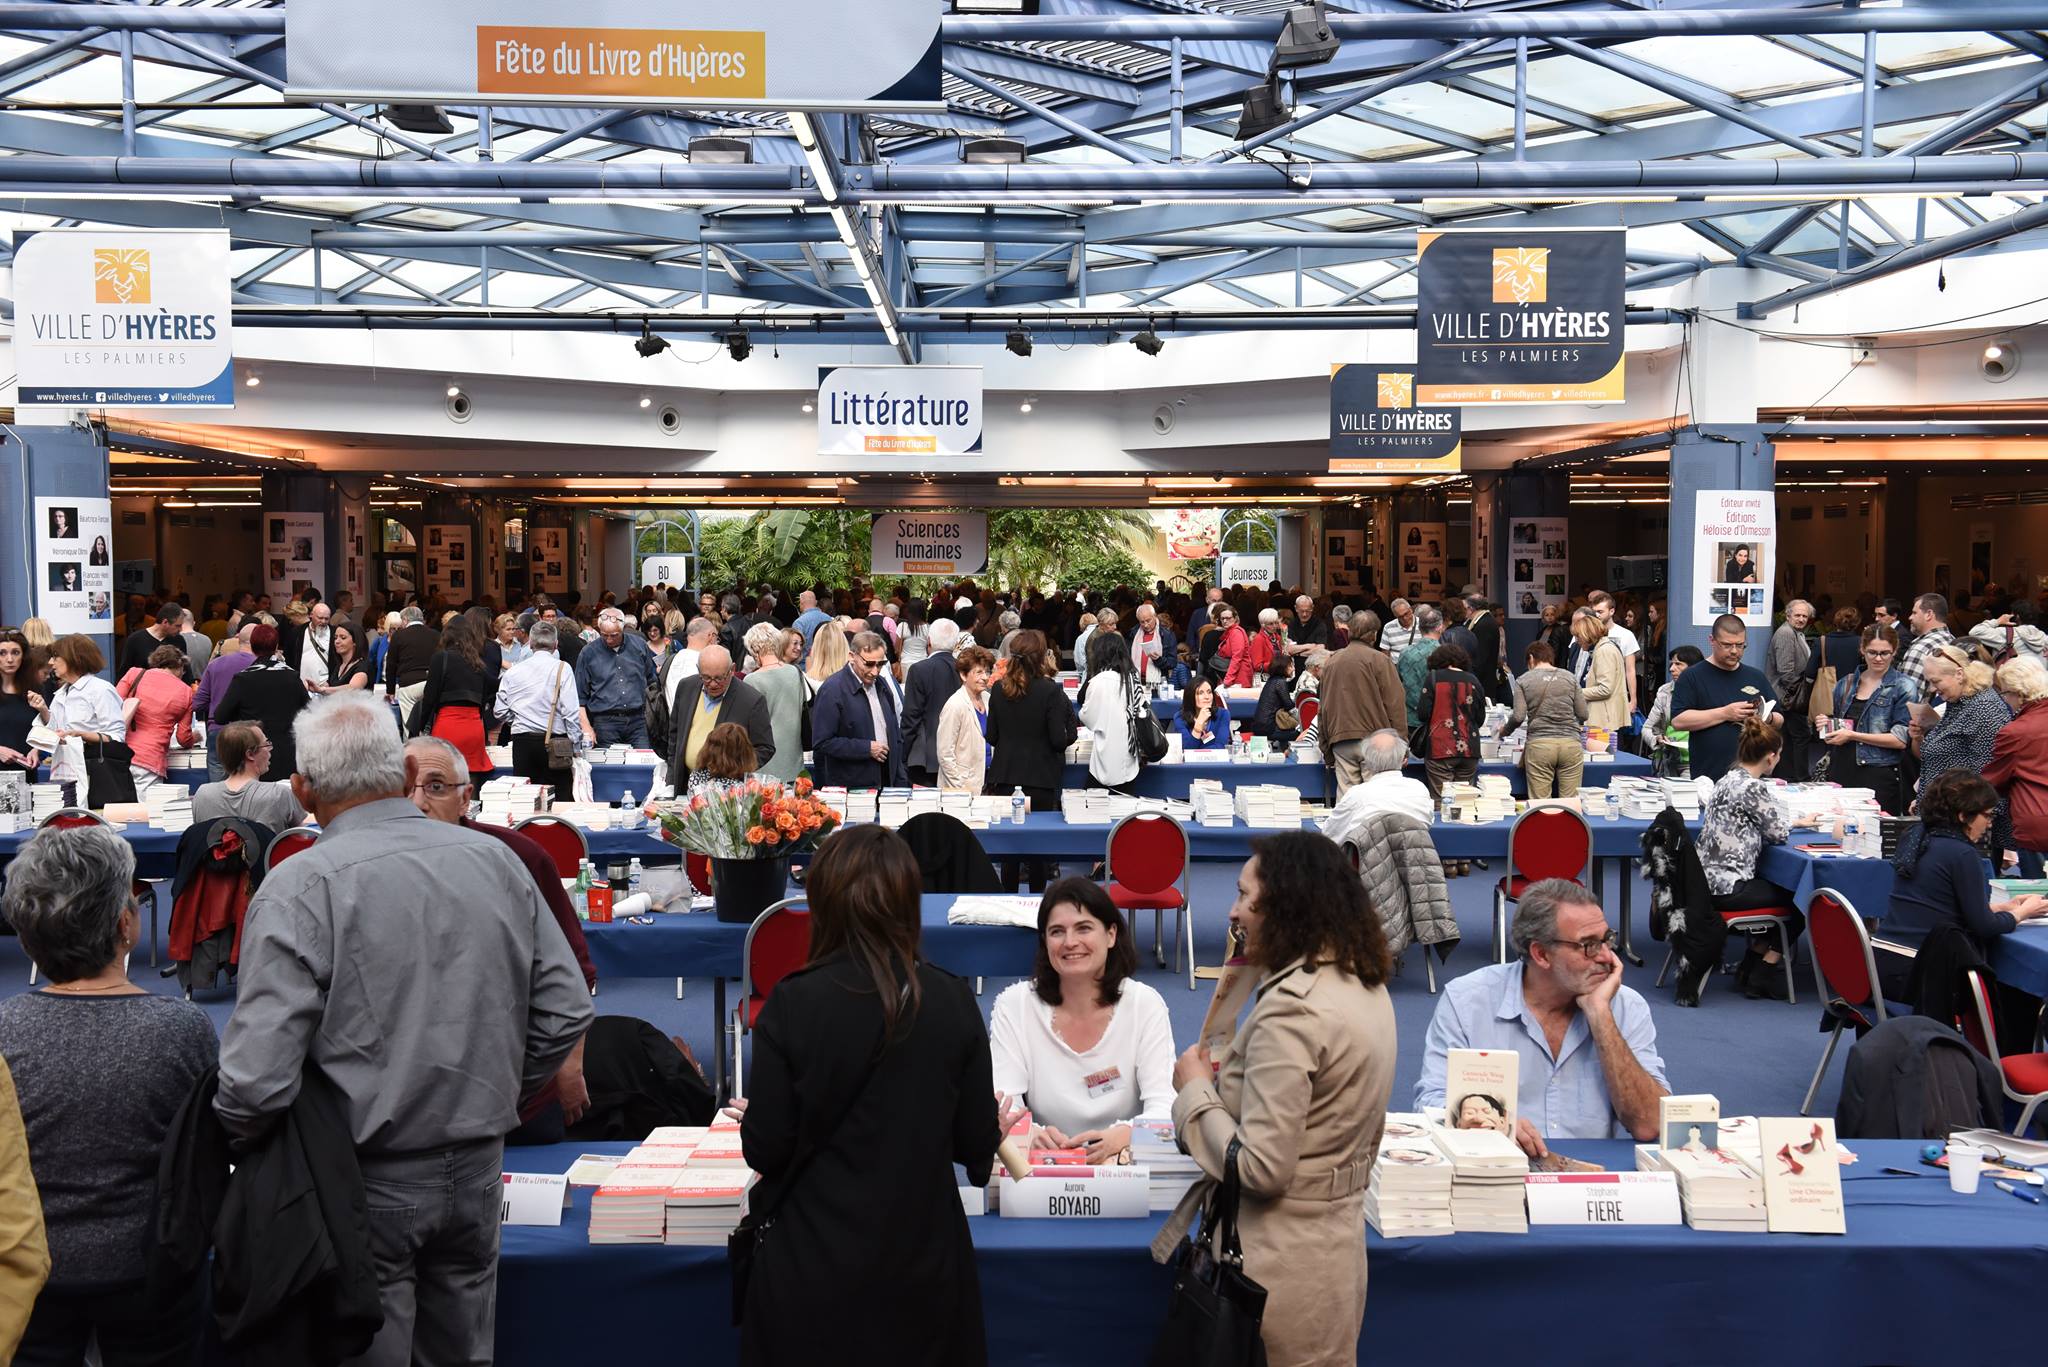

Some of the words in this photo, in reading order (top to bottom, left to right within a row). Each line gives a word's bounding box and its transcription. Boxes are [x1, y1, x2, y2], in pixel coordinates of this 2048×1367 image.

[495, 40, 546, 74] Fête
[553, 41, 581, 75] du
[588, 42, 641, 77] Livre
[649, 43, 746, 83] d'Hyères
[32, 313, 91, 340] VILLE
[102, 307, 217, 341] D'HYÈRES
[1432, 312, 1490, 339] VILLE
[1500, 306, 1610, 339] D'HYÈRES
[64, 352, 92, 364] LES
[103, 352, 187, 364] PALMIERS
[1462, 350, 1489, 362] LES
[1499, 350, 1580, 362] PALMIERS
[36, 392, 89, 403] www.hyeres.fr
[107, 392, 153, 403] villedhyeres
[171, 392, 216, 403] villedhyeres
[831, 390, 969, 426] Littérature
[1339, 413, 1377, 431] VILLE
[1382, 410, 1453, 431] D'HYÈRES
[1358, 437, 1376, 446] LES
[1381, 437, 1434, 446] PALMIERS
[1726, 509, 1757, 524] Éditions
[898, 519, 960, 539] Sciences
[1703, 523, 1732, 536] Héloïse
[895, 540, 962, 560] humaines
[658, 565, 670, 580] BD
[1229, 567, 1268, 581] Jeunesse
[1064, 1181, 1086, 1193] Aurore
[1048, 1195, 1101, 1216] BOYARD
[1586, 1200, 1625, 1222] FIERE
